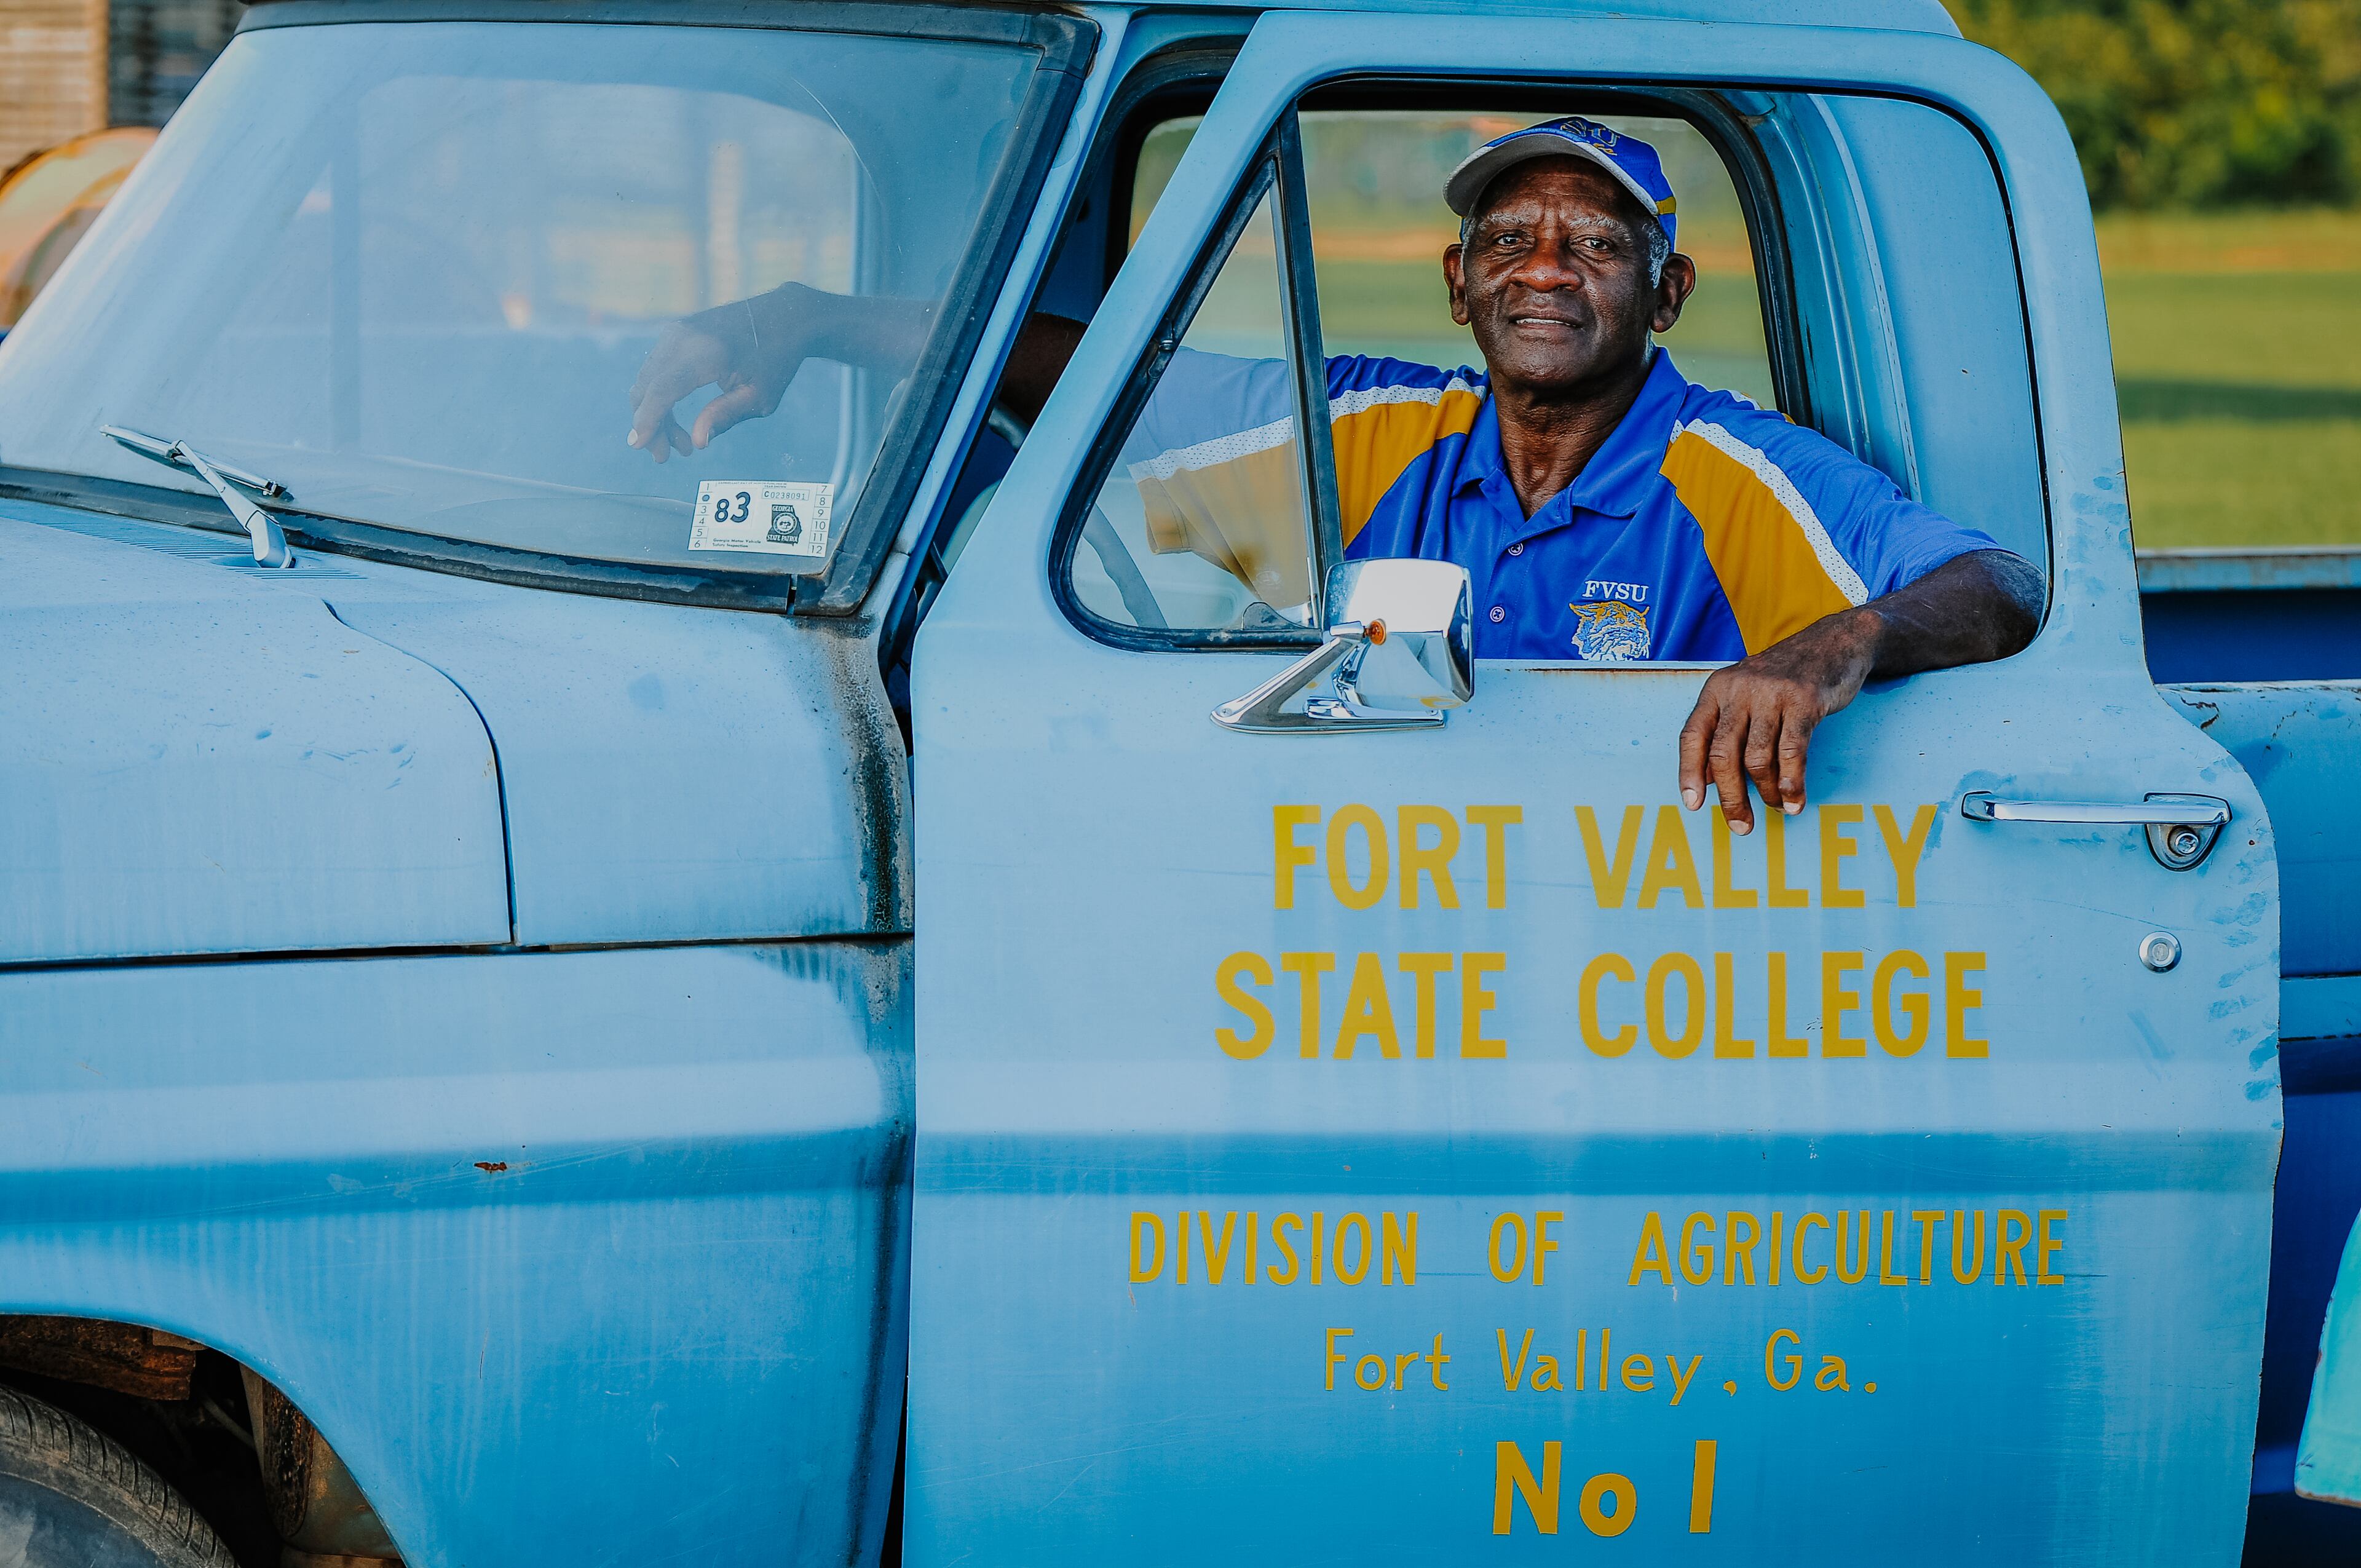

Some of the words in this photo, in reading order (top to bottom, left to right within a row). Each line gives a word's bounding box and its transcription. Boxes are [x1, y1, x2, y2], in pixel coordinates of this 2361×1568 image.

[714, 492, 751, 523] 83
[819, 497, 825, 505] 8
[813, 533, 822, 542] 11
[815, 521, 826, 530] 10
[812, 545, 823, 554] 12
[1582, 580, 1649, 602] FVSU
[1273, 804, 1523, 909] FORT
[1574, 804, 1938, 908] VALLEY
[1216, 951, 1507, 1059] STATE
[1578, 950, 1990, 1059] COLLEGE
[1129, 1211, 1418, 1286] DIVISION
[1488, 1211, 1564, 1285] OF
[1627, 1210, 2068, 1285] AGRICULTURE
[1324, 1328, 1450, 1391] Fort
[1765, 1329, 1877, 1393] Ga.
[1492, 1440, 1637, 1537] No
